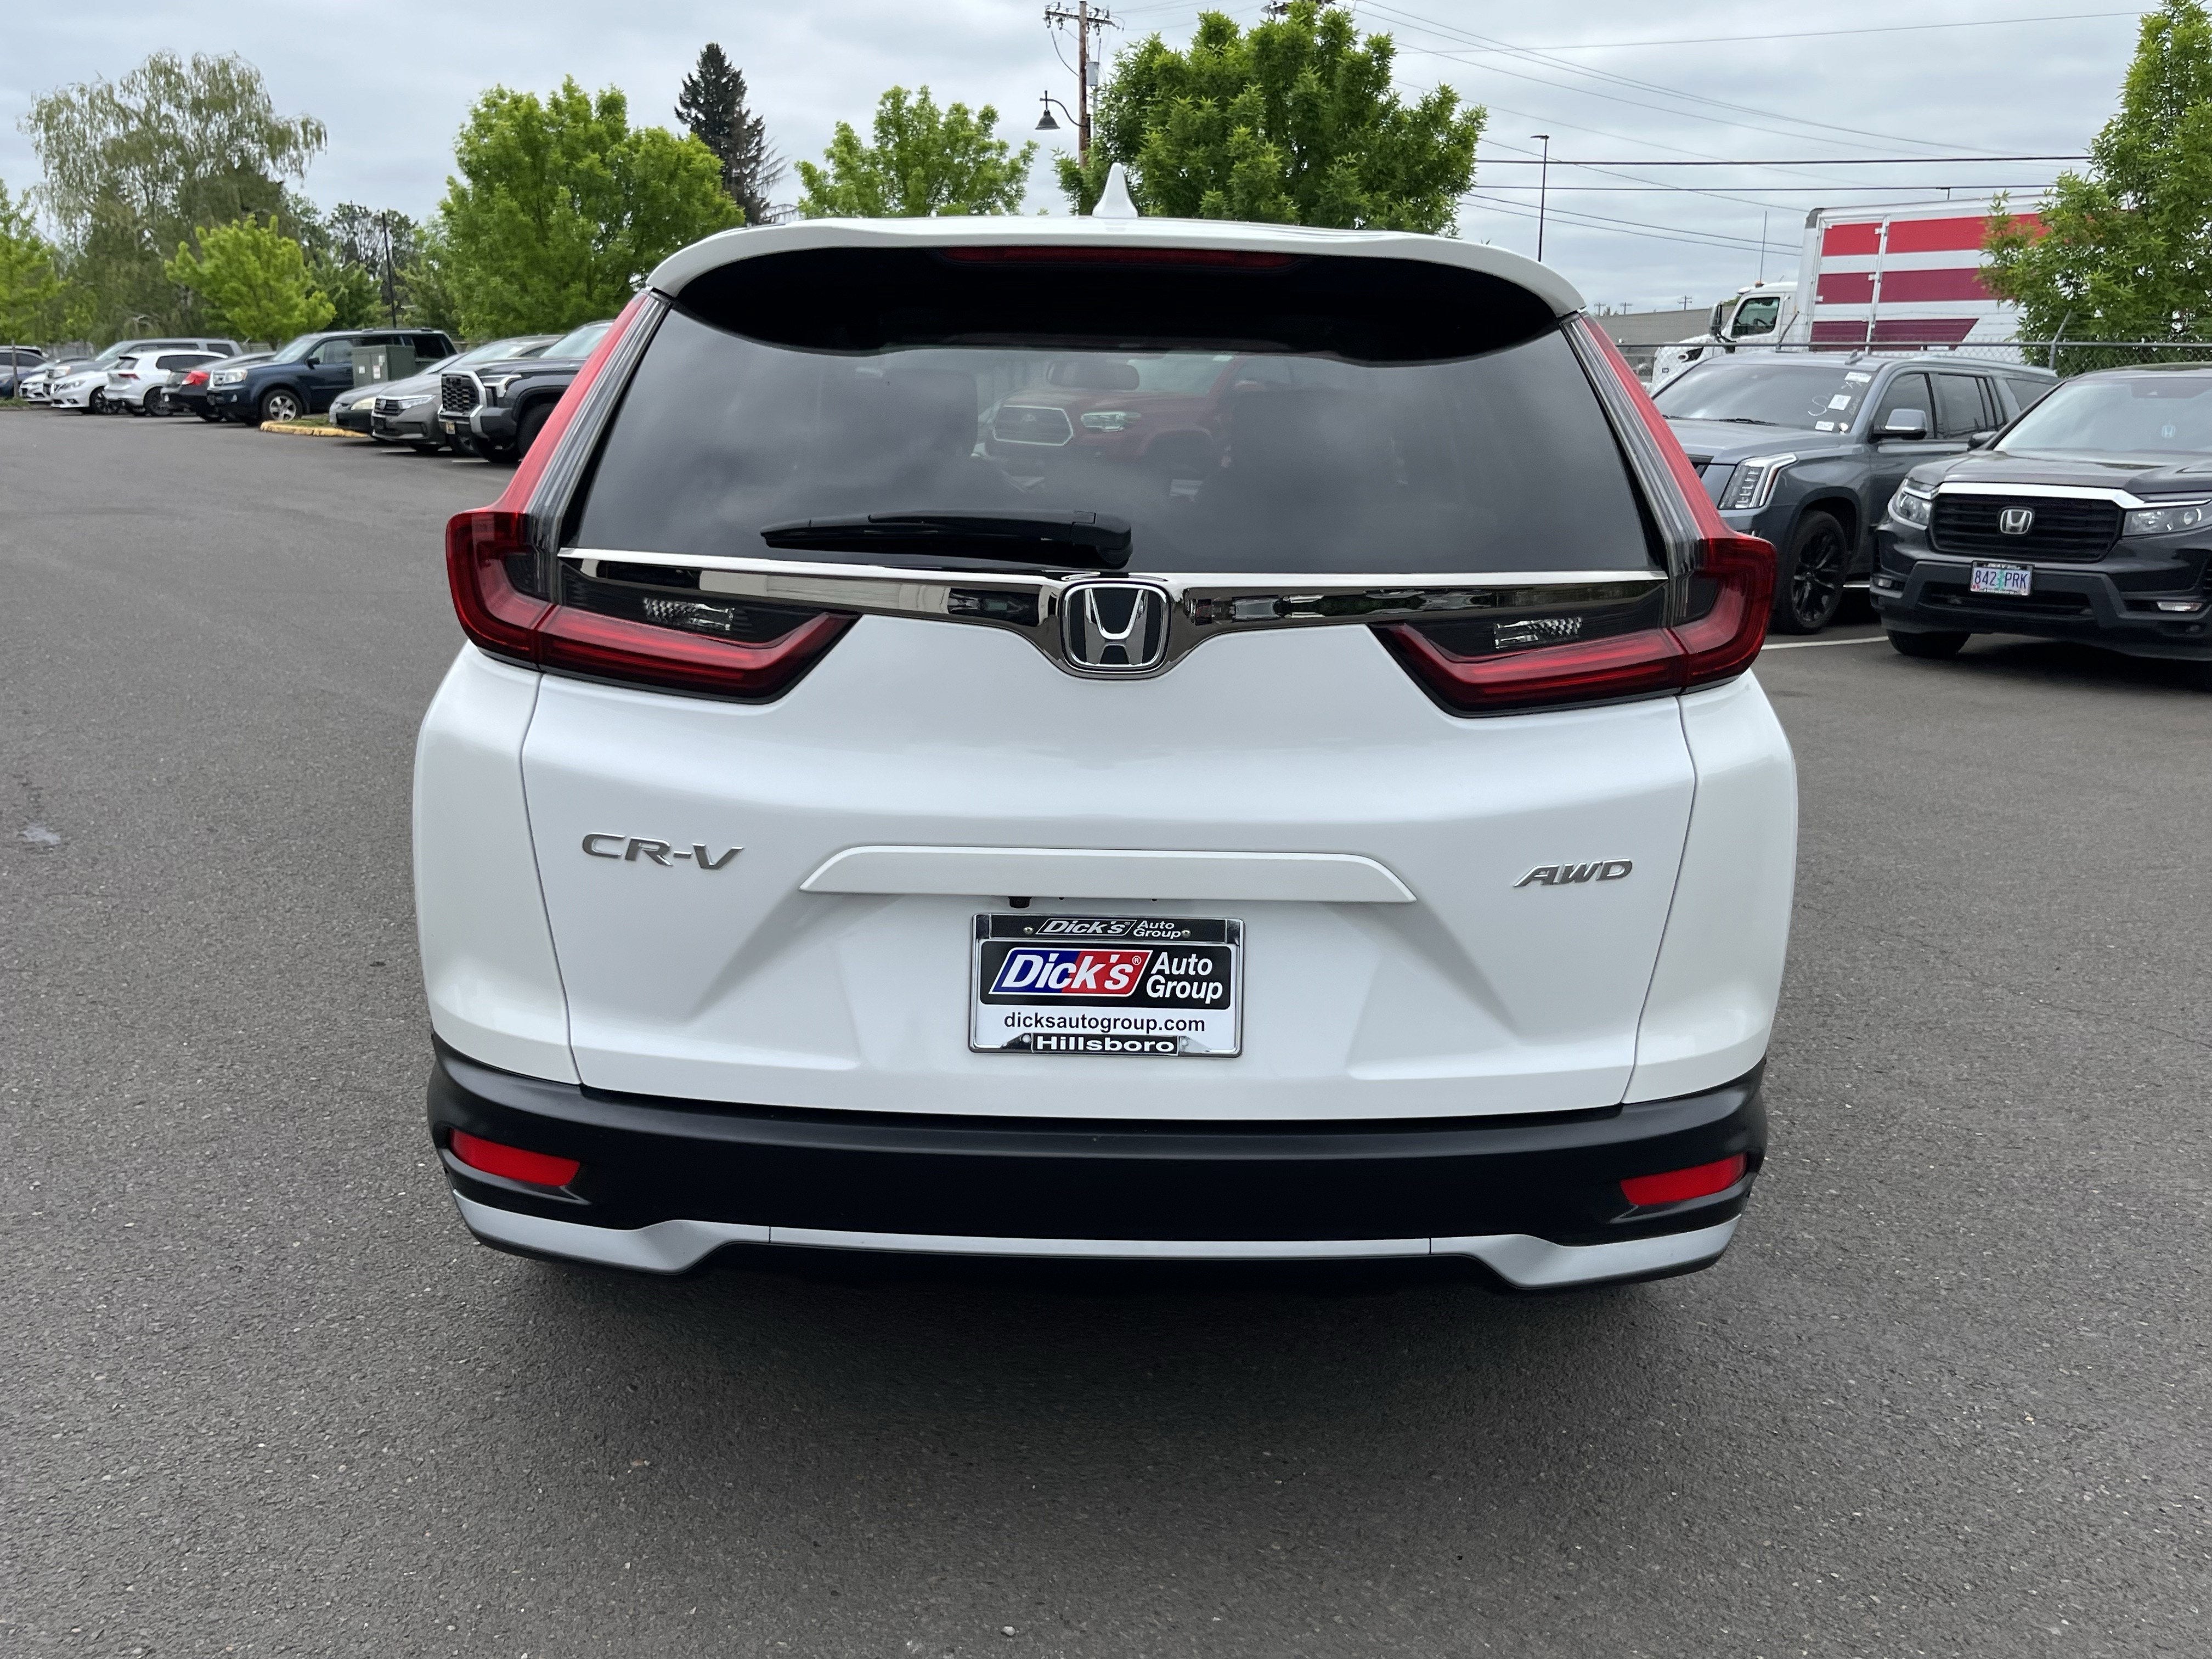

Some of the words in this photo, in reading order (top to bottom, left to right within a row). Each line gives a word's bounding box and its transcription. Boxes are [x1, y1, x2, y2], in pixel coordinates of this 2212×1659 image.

[1974, 570, 1997, 586] 842
[2004, 572, 2028, 589] PRK
[582, 832, 745, 870] CR-V
[1513, 858, 1633, 887] AWD
[1133, 929, 1181, 939] Group
[1137, 920, 1175, 930] Auto
[1152, 952, 1212, 975] Auto
[1146, 975, 1223, 1004] Group
[1004, 1012, 1205, 1034] dicksautogroup.com
[1037, 1036, 1175, 1053] Hillsboro
